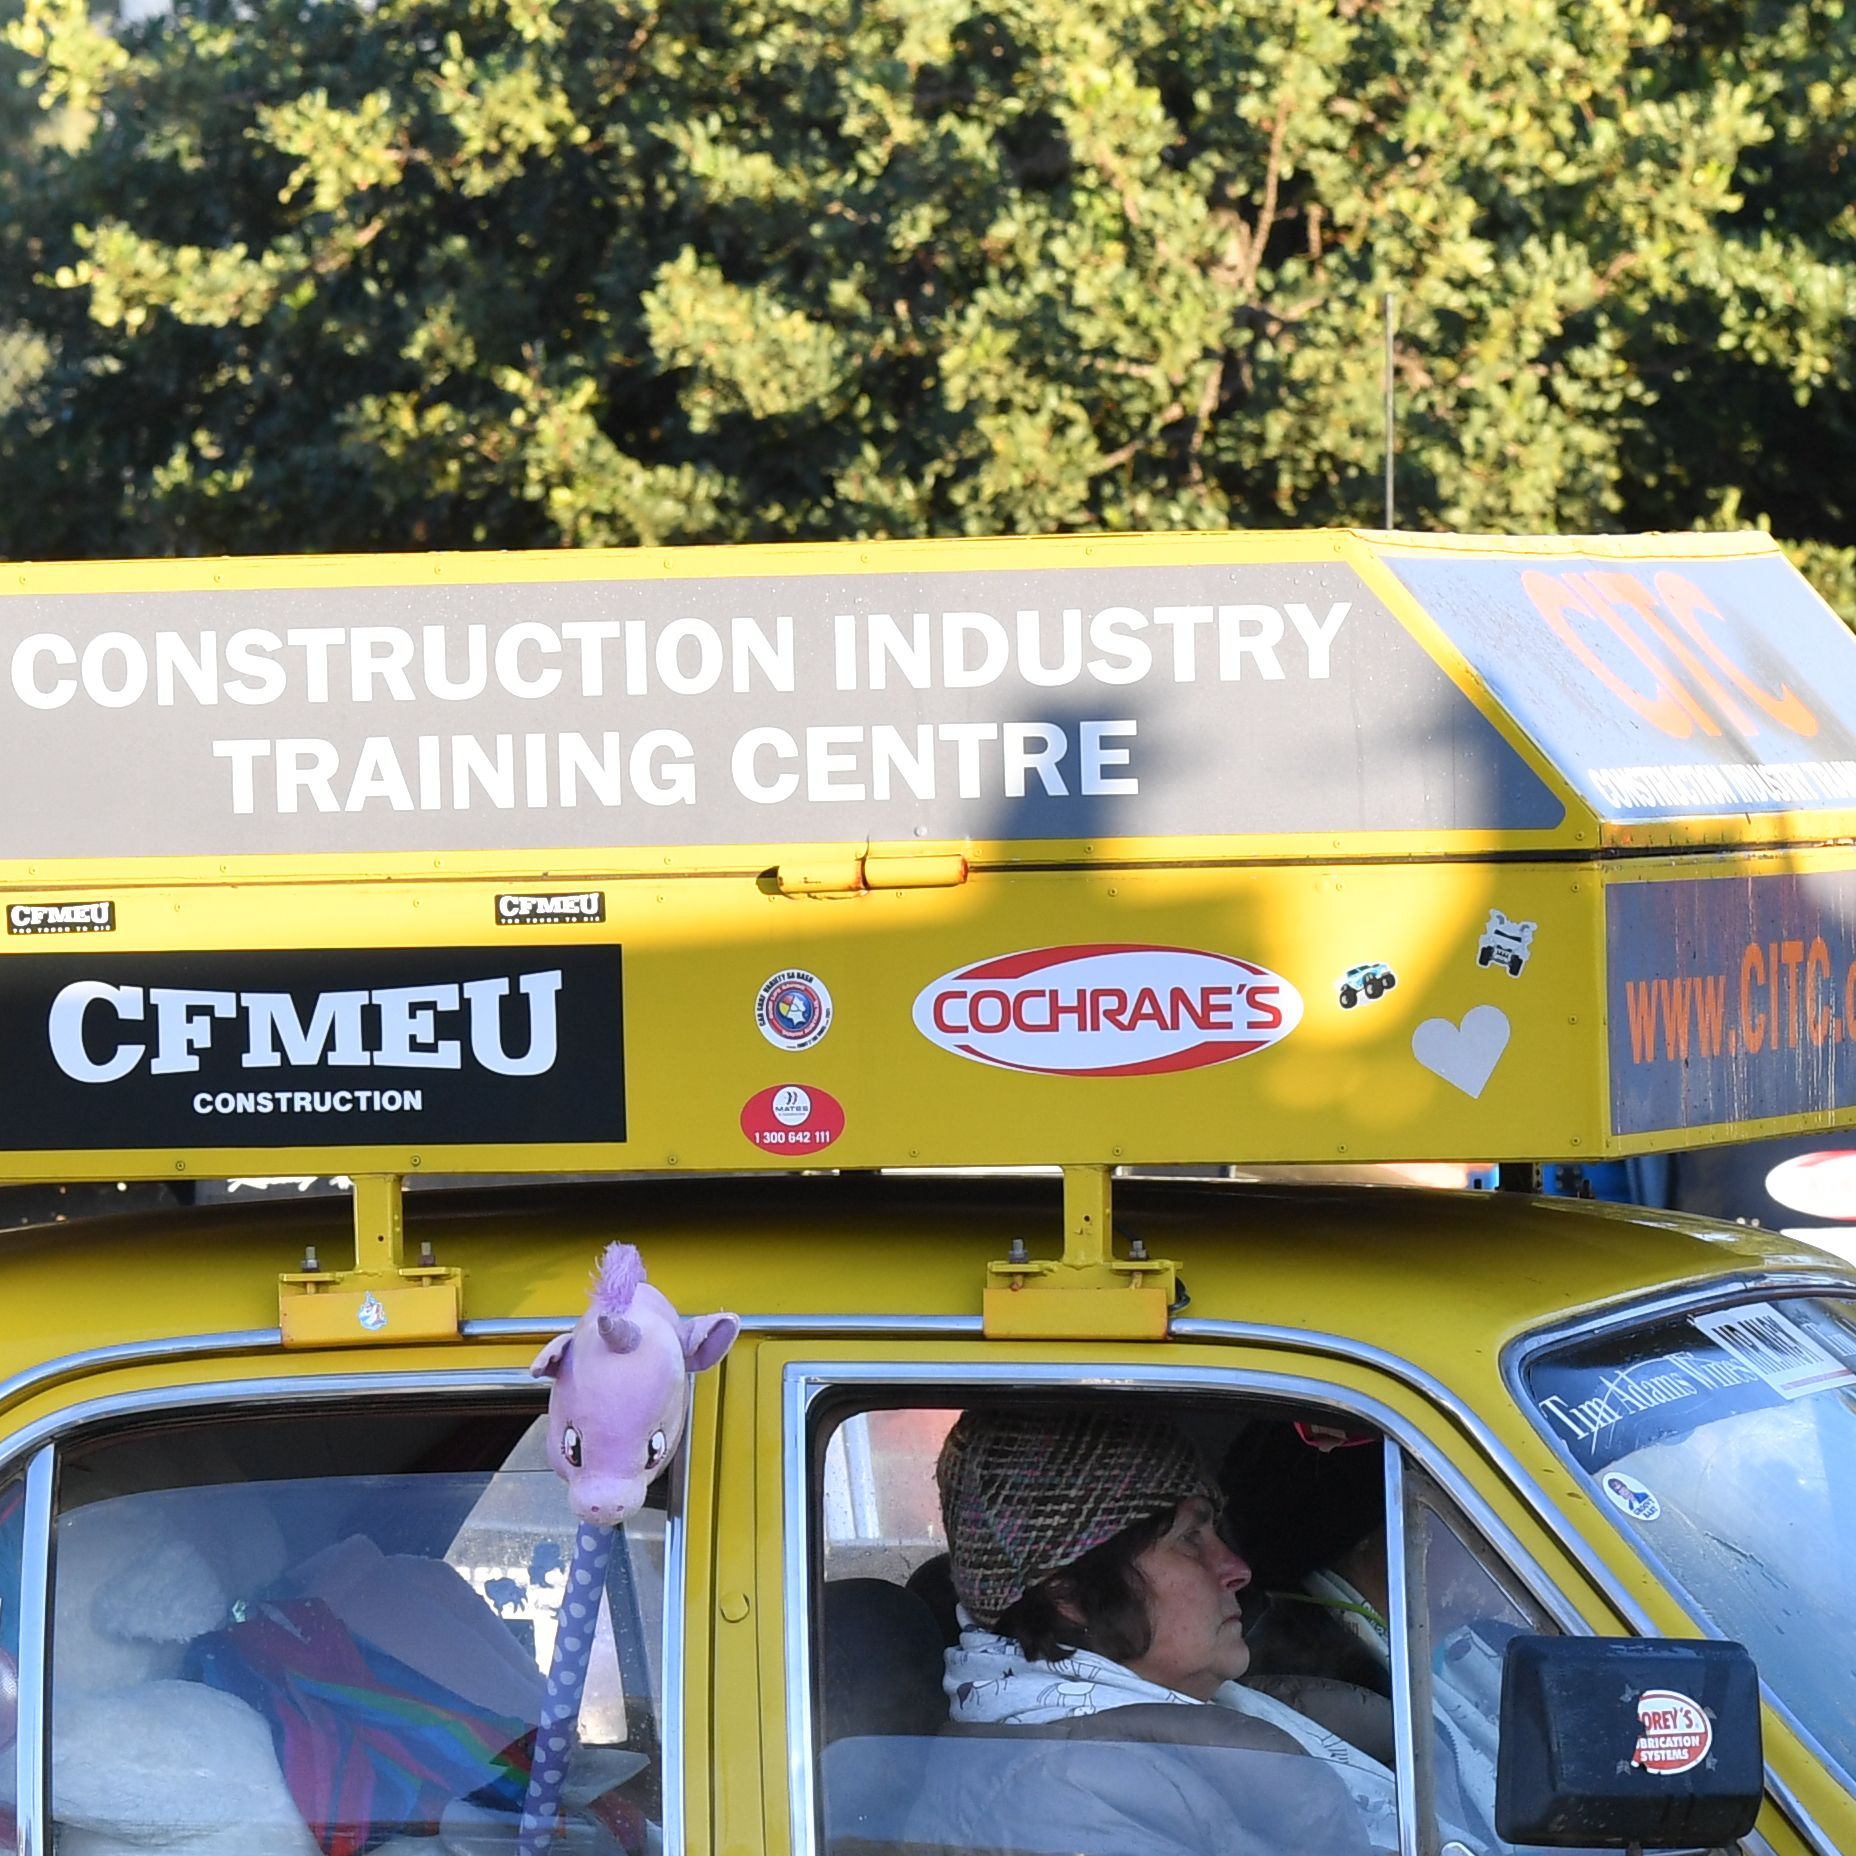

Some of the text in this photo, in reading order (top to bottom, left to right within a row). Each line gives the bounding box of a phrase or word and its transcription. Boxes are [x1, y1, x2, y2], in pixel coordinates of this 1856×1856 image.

[10, 602, 1352, 710] CONSTRUCTION INDUSTRY
[1522, 571, 1817, 738] CITC
[214, 719, 1140, 816] TRAINING CENTRE
[10, 901, 110, 927] CFMEU
[499, 892, 600, 917] CFMEU
[49, 968, 563, 1084] CFMEU
[931, 984, 1284, 1036] COCHRANE'S
[192, 1089, 425, 1116] CONSTRUCTION
[755, 1131, 830, 1144] 1 300 642 111
[1539, 1350, 1760, 1442] Tim Adams Wines
[1638, 1706, 1694, 1730] OREY'S
[1640, 1748, 1689, 1762] SYSTEMS
